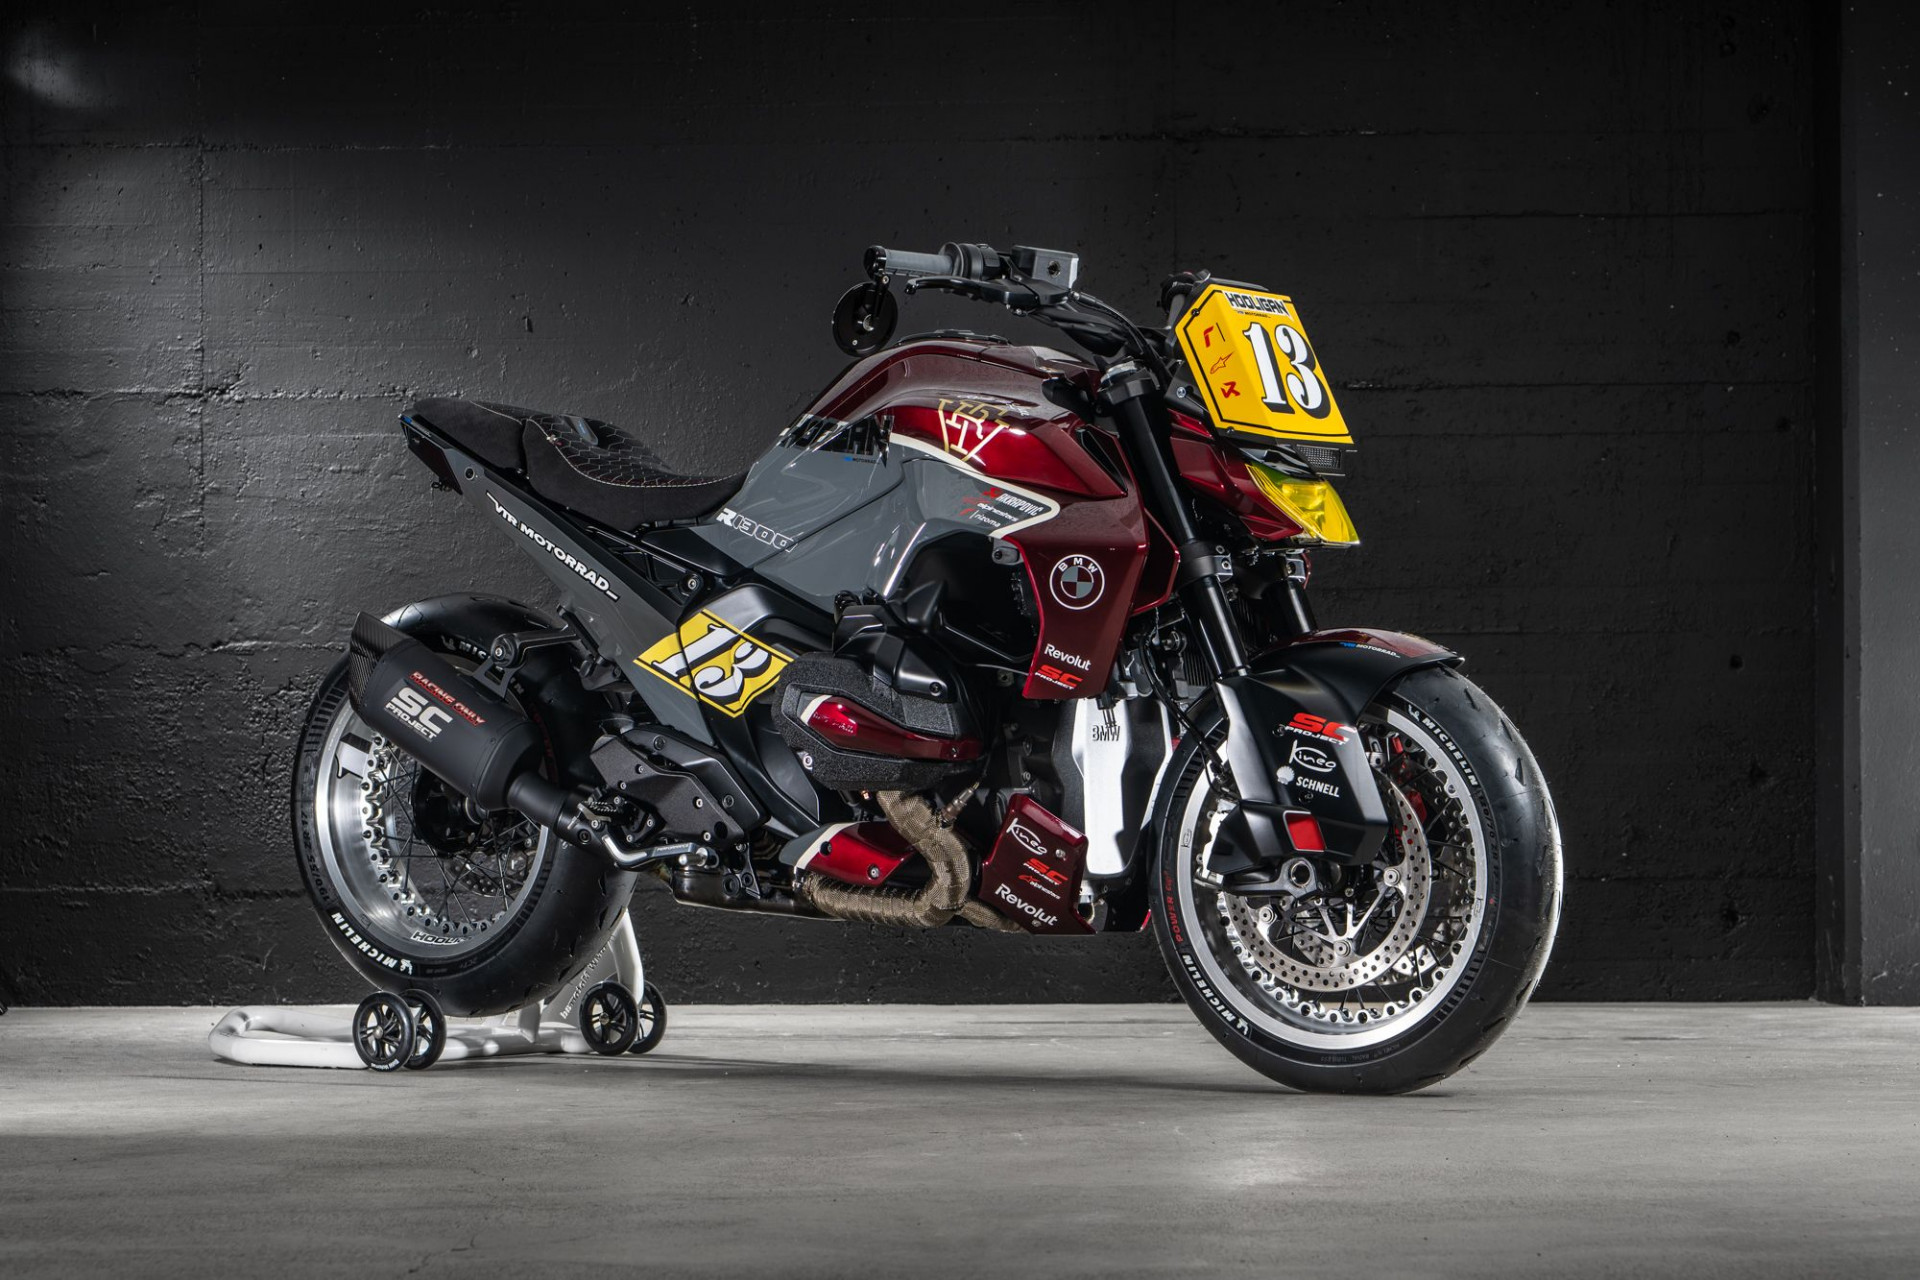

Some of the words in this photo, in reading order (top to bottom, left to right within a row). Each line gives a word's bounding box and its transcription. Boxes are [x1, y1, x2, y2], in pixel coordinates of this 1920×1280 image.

[1224, 291, 1290, 317] HOOLIGAN
[1243, 321, 1331, 419] 13
[974, 512, 1001, 528] rizoma
[490, 495, 518, 526] VTR
[520, 521, 613, 595] MOTORRAD
[1058, 557, 1098, 573] BMW
[651, 623, 772, 705] 13
[1044, 643, 1092, 671] Revolut
[1034, 671, 1075, 690] PROJECT
[1037, 664, 1084, 688] SC
[391, 687, 454, 734] SC
[409, 671, 457, 705] RACING
[452, 702, 486, 728] ONLY
[385, 702, 437, 739] PROJECT
[1092, 725, 1121, 742] BMW
[1284, 725, 1347, 746] PROJECT
[1288, 712, 1357, 741] SC
[1288, 739, 1337, 773] Kineo
[1421, 717, 1479, 786] MICHELIN
[1295, 776, 1340, 798] SCHNELL
[1006, 817, 1048, 856] Kineo
[1027, 858, 1069, 885] SC
[994, 883, 1059, 926] Revolut
[1165, 896, 1184, 944] POWER
[330, 911, 399, 969] MICHELIN
[1182, 954, 1237, 1023] MICHELIN
